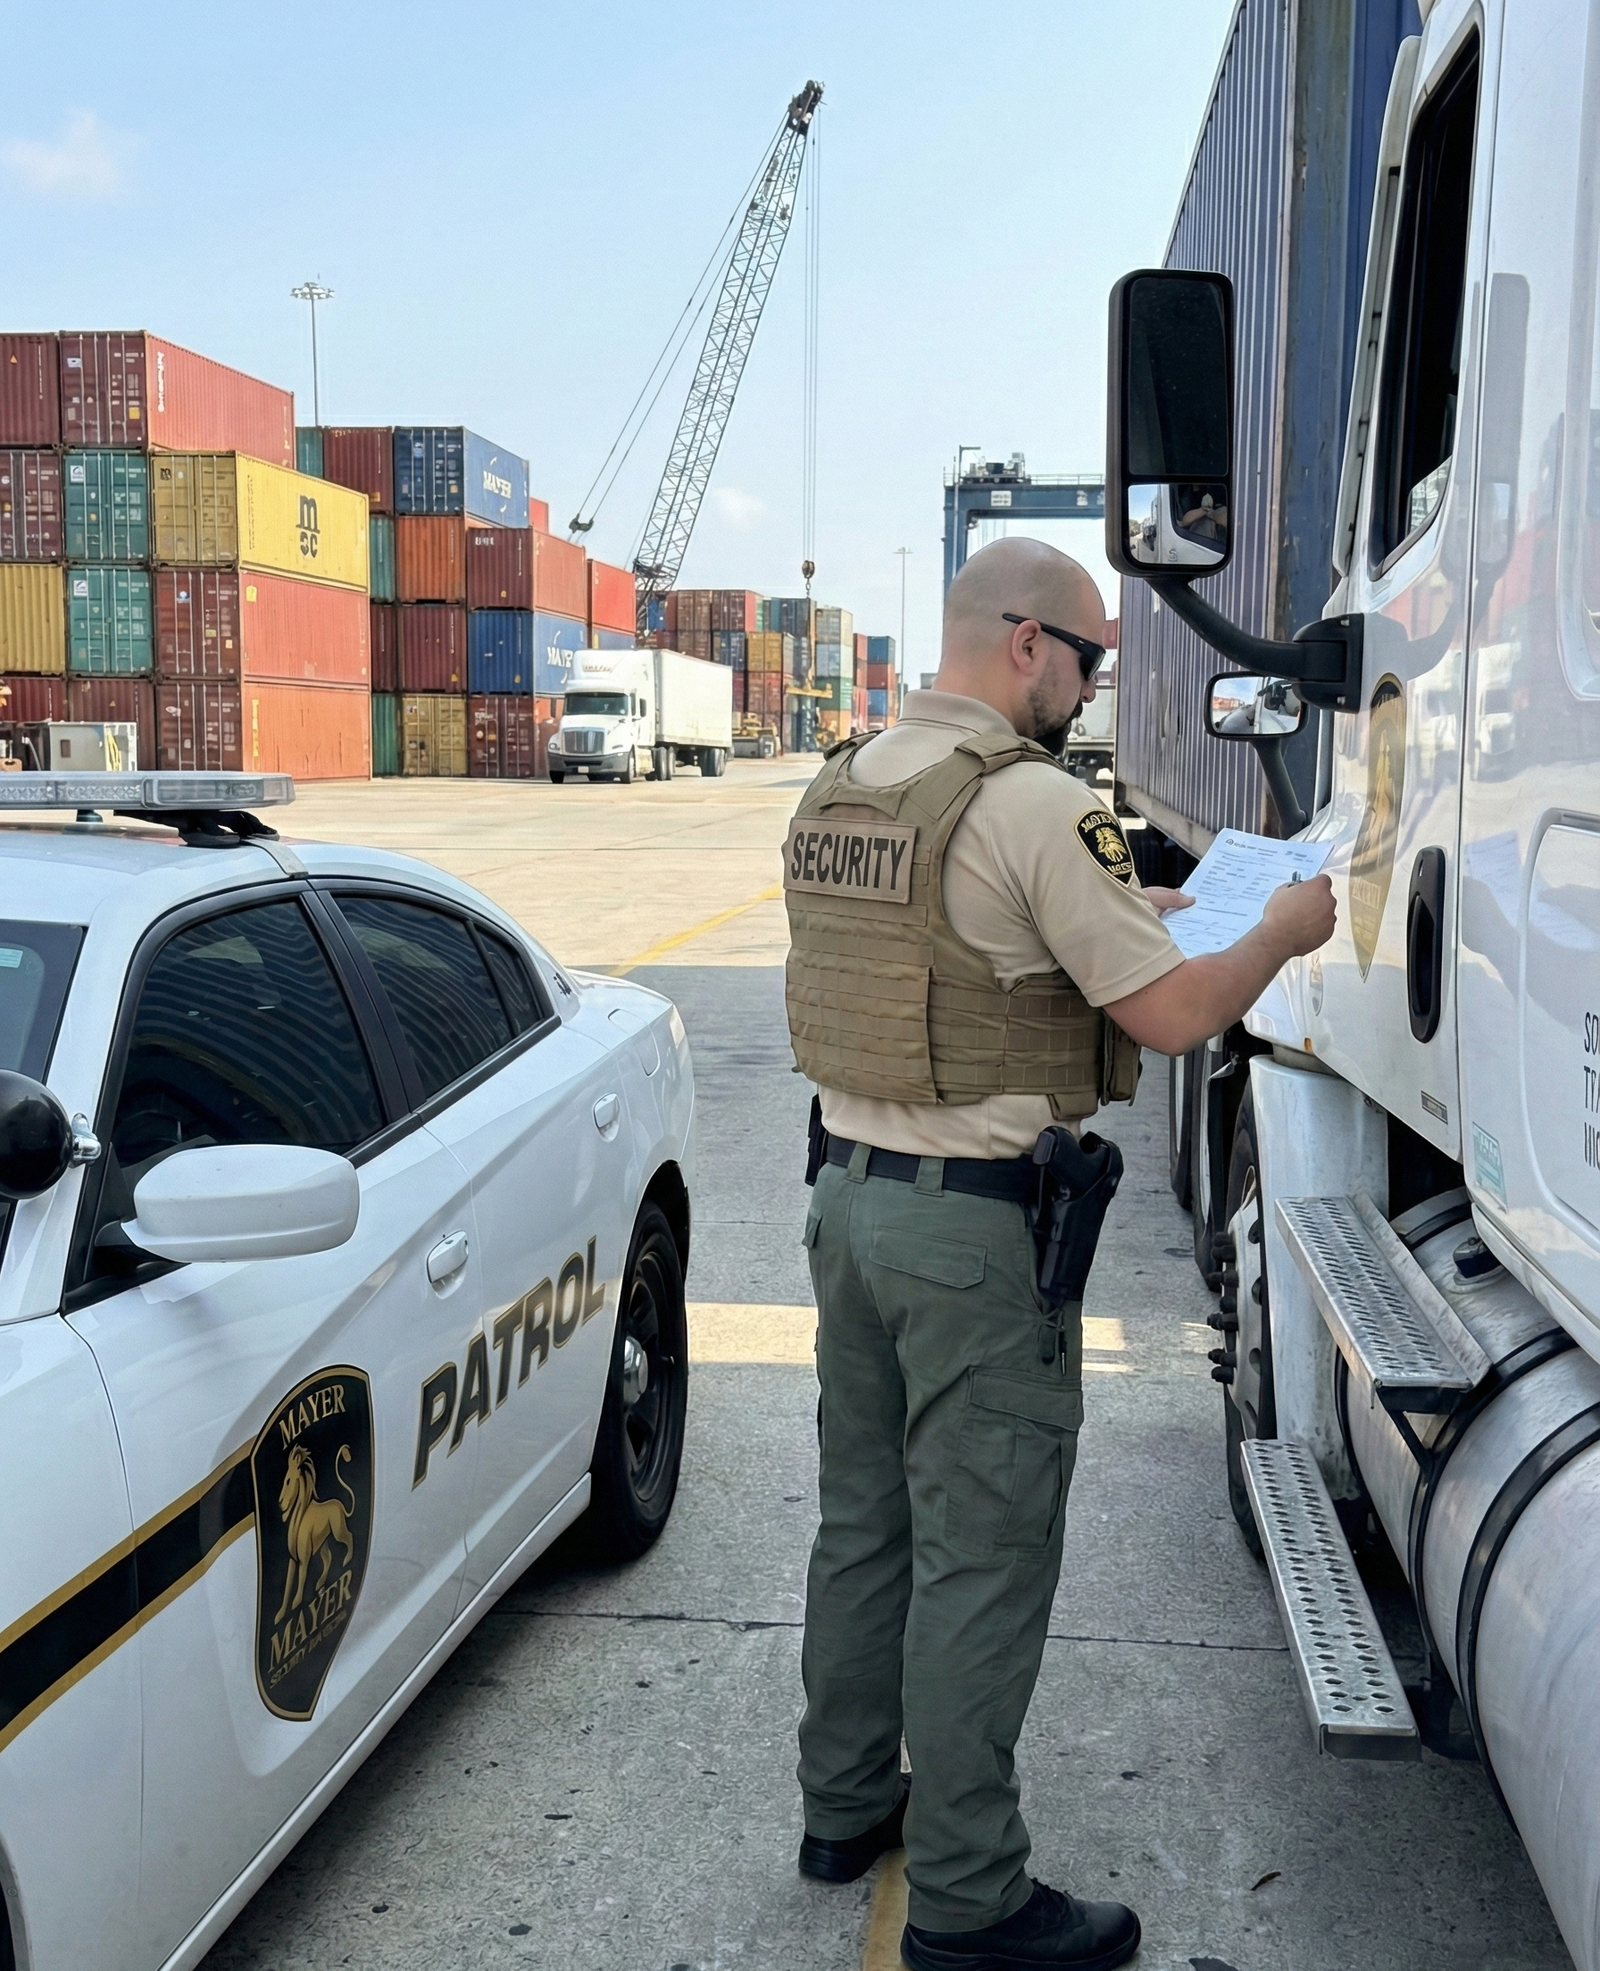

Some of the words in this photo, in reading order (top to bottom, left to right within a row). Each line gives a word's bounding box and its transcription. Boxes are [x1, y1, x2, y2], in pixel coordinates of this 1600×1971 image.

[790, 831, 908, 891] SECURITY
[411, 1234, 606, 1493] PATROL
[279, 1384, 346, 1451] MAYER
[267, 1569, 352, 1675] MAYER
